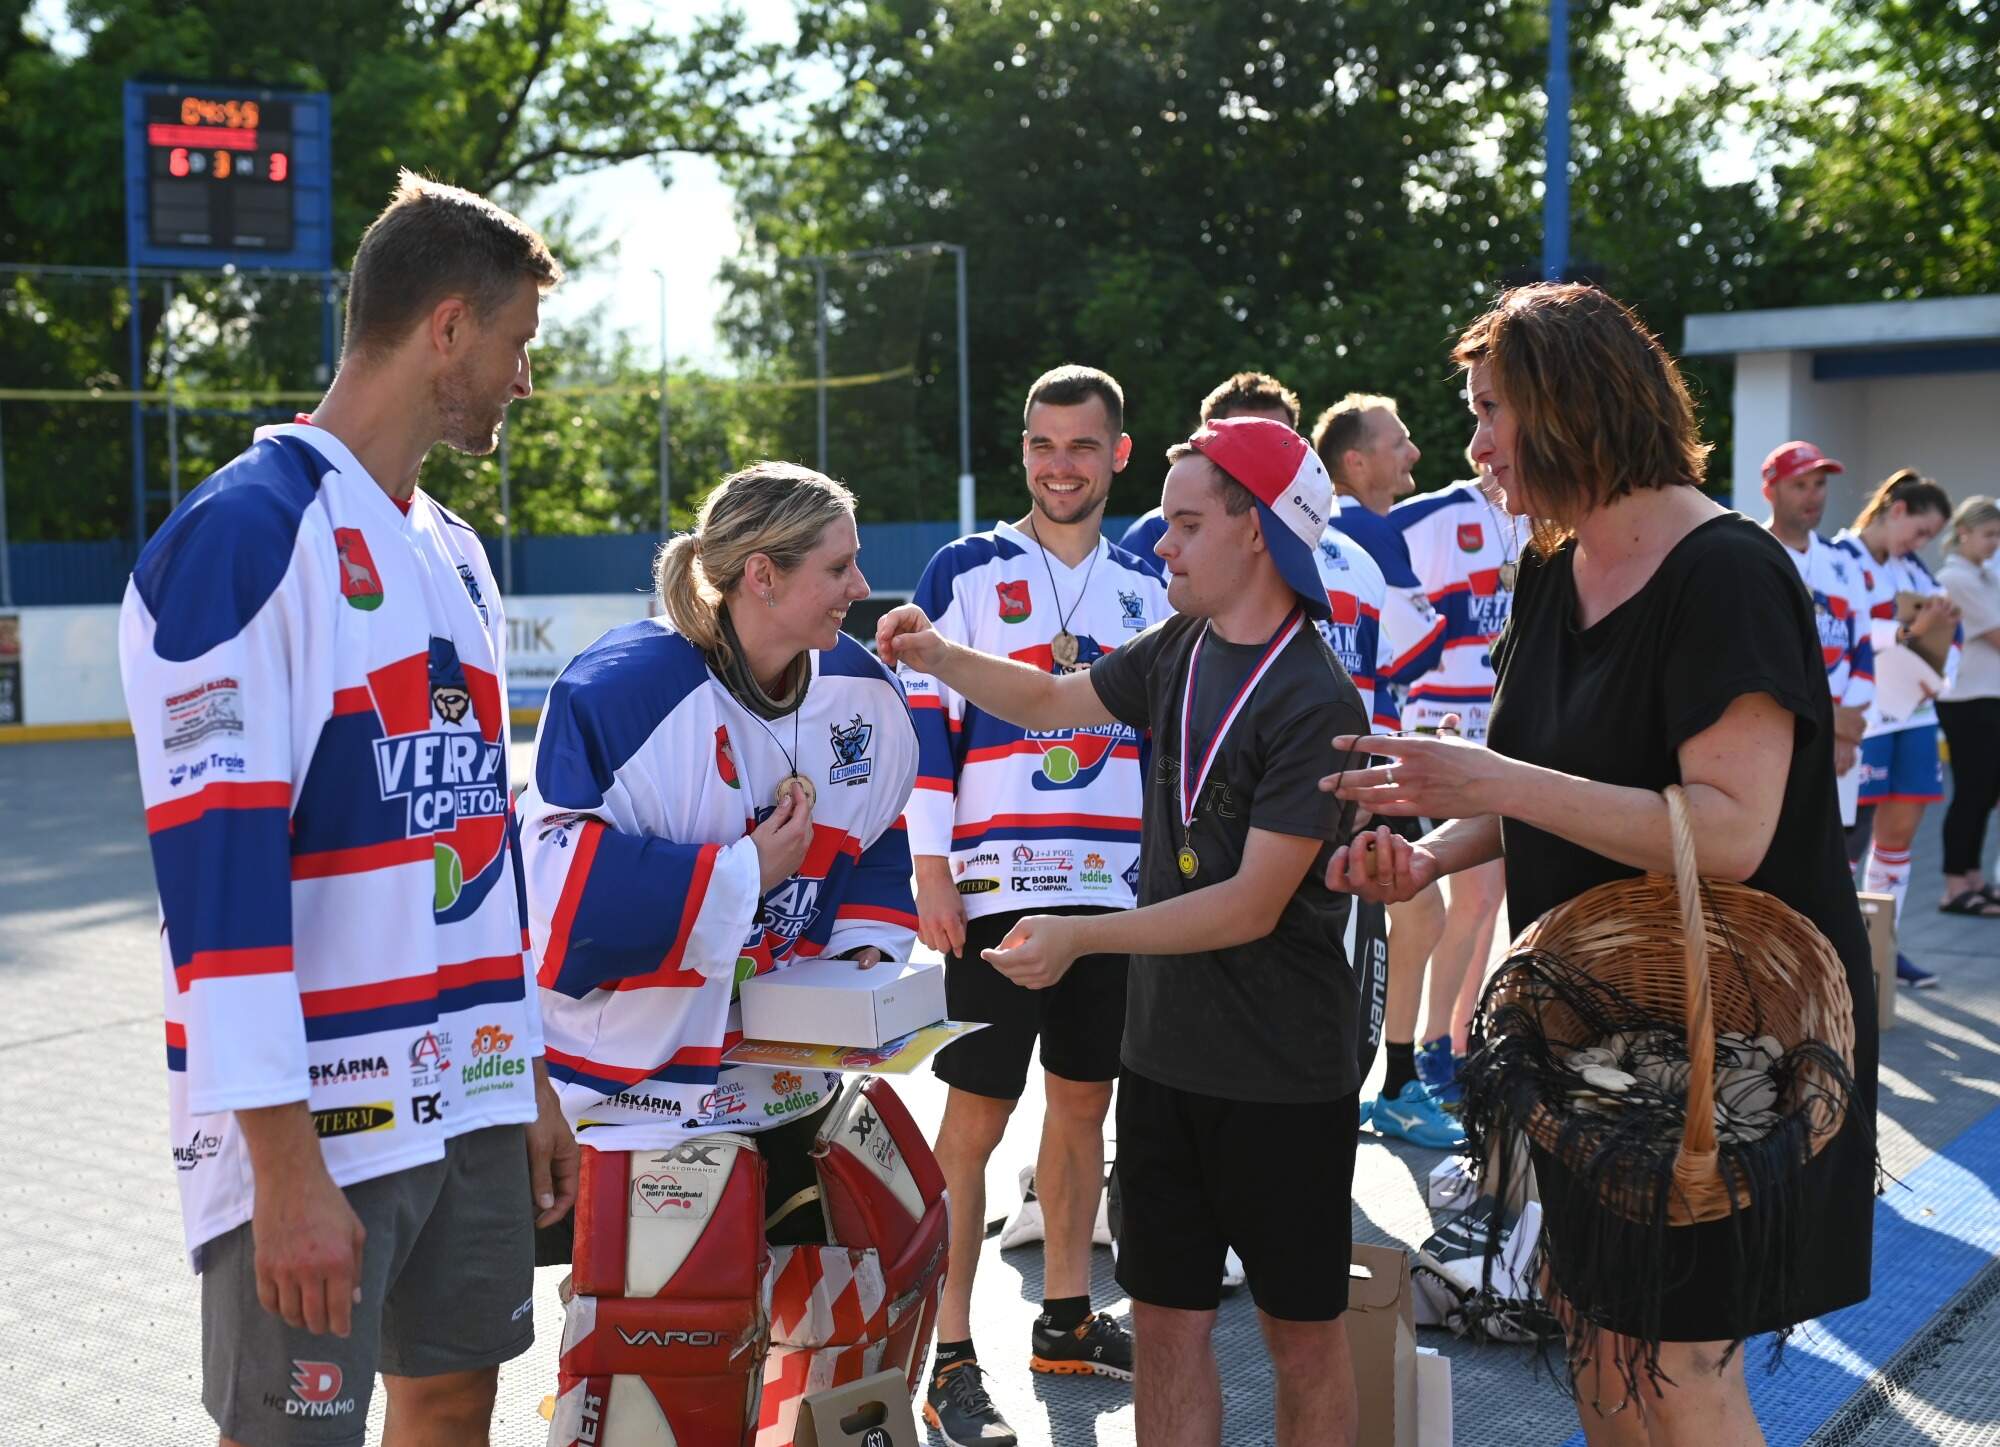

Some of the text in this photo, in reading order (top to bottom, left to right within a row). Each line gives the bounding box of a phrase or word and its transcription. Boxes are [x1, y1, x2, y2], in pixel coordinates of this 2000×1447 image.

[1032, 876, 1068, 884] BOBUN
[1080, 870, 1113, 883] teddies
[1368, 938, 1386, 1047] BAUER
[462, 1054, 525, 1084] teddies
[763, 1091, 820, 1117] teddies
[642, 1183, 682, 1192] Moje srdce
[285, 1398, 355, 1417] DYNAMO
